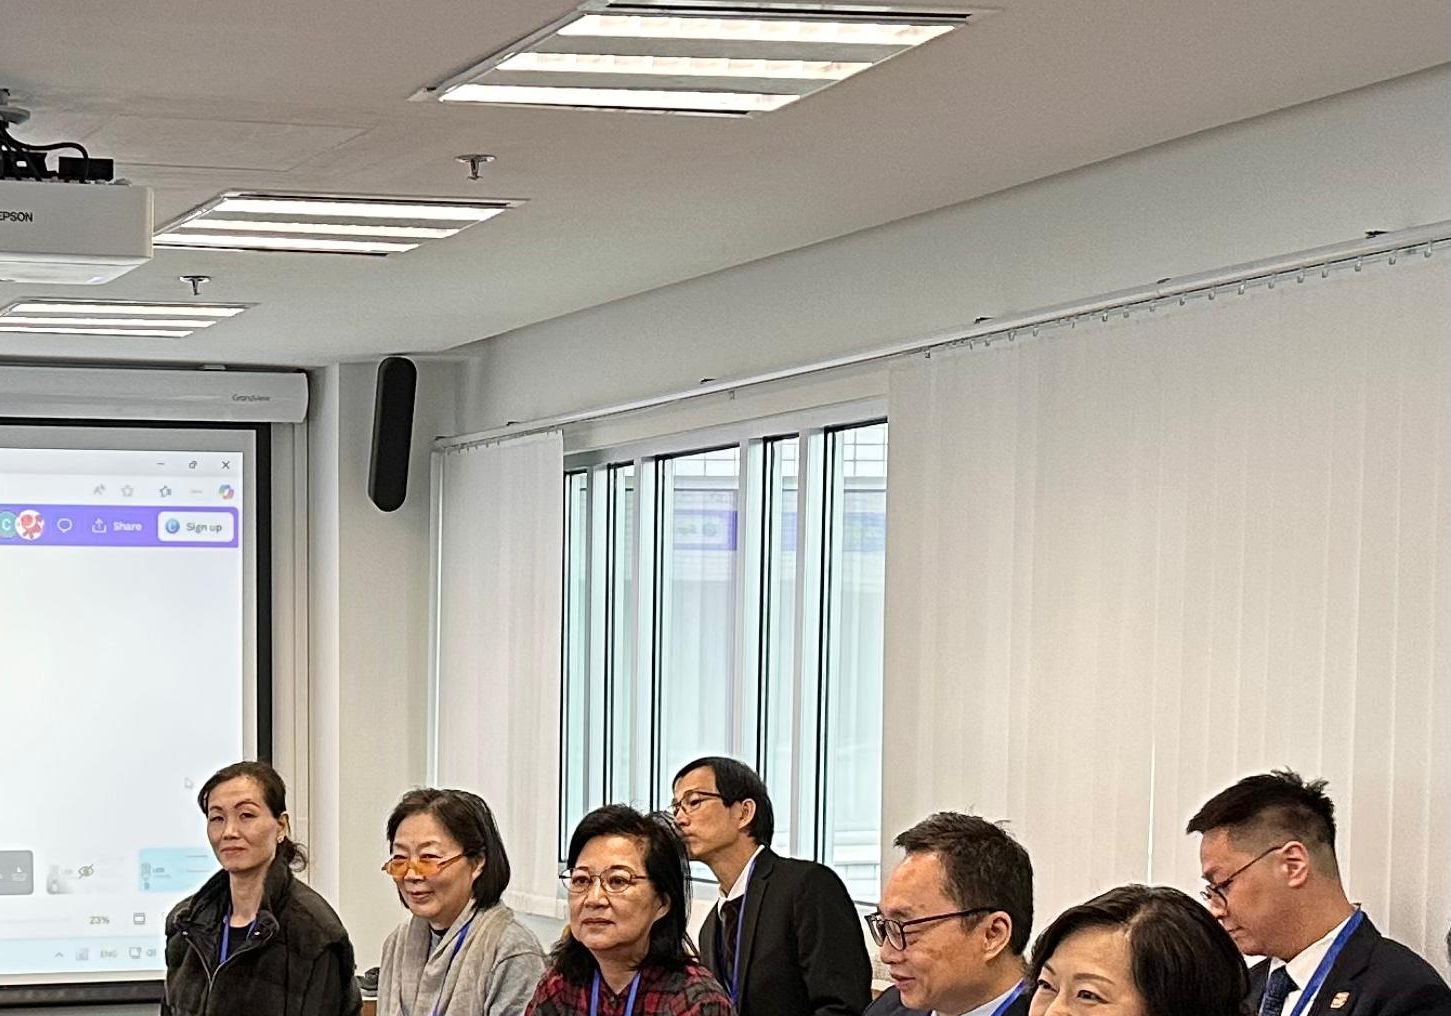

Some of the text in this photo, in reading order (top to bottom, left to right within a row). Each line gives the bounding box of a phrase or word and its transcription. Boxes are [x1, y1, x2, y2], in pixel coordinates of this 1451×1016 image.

[1, 518, 12, 531] C
[113, 521, 143, 532] Share
[186, 521, 208, 534] Sign
[209, 524, 223, 535] up
